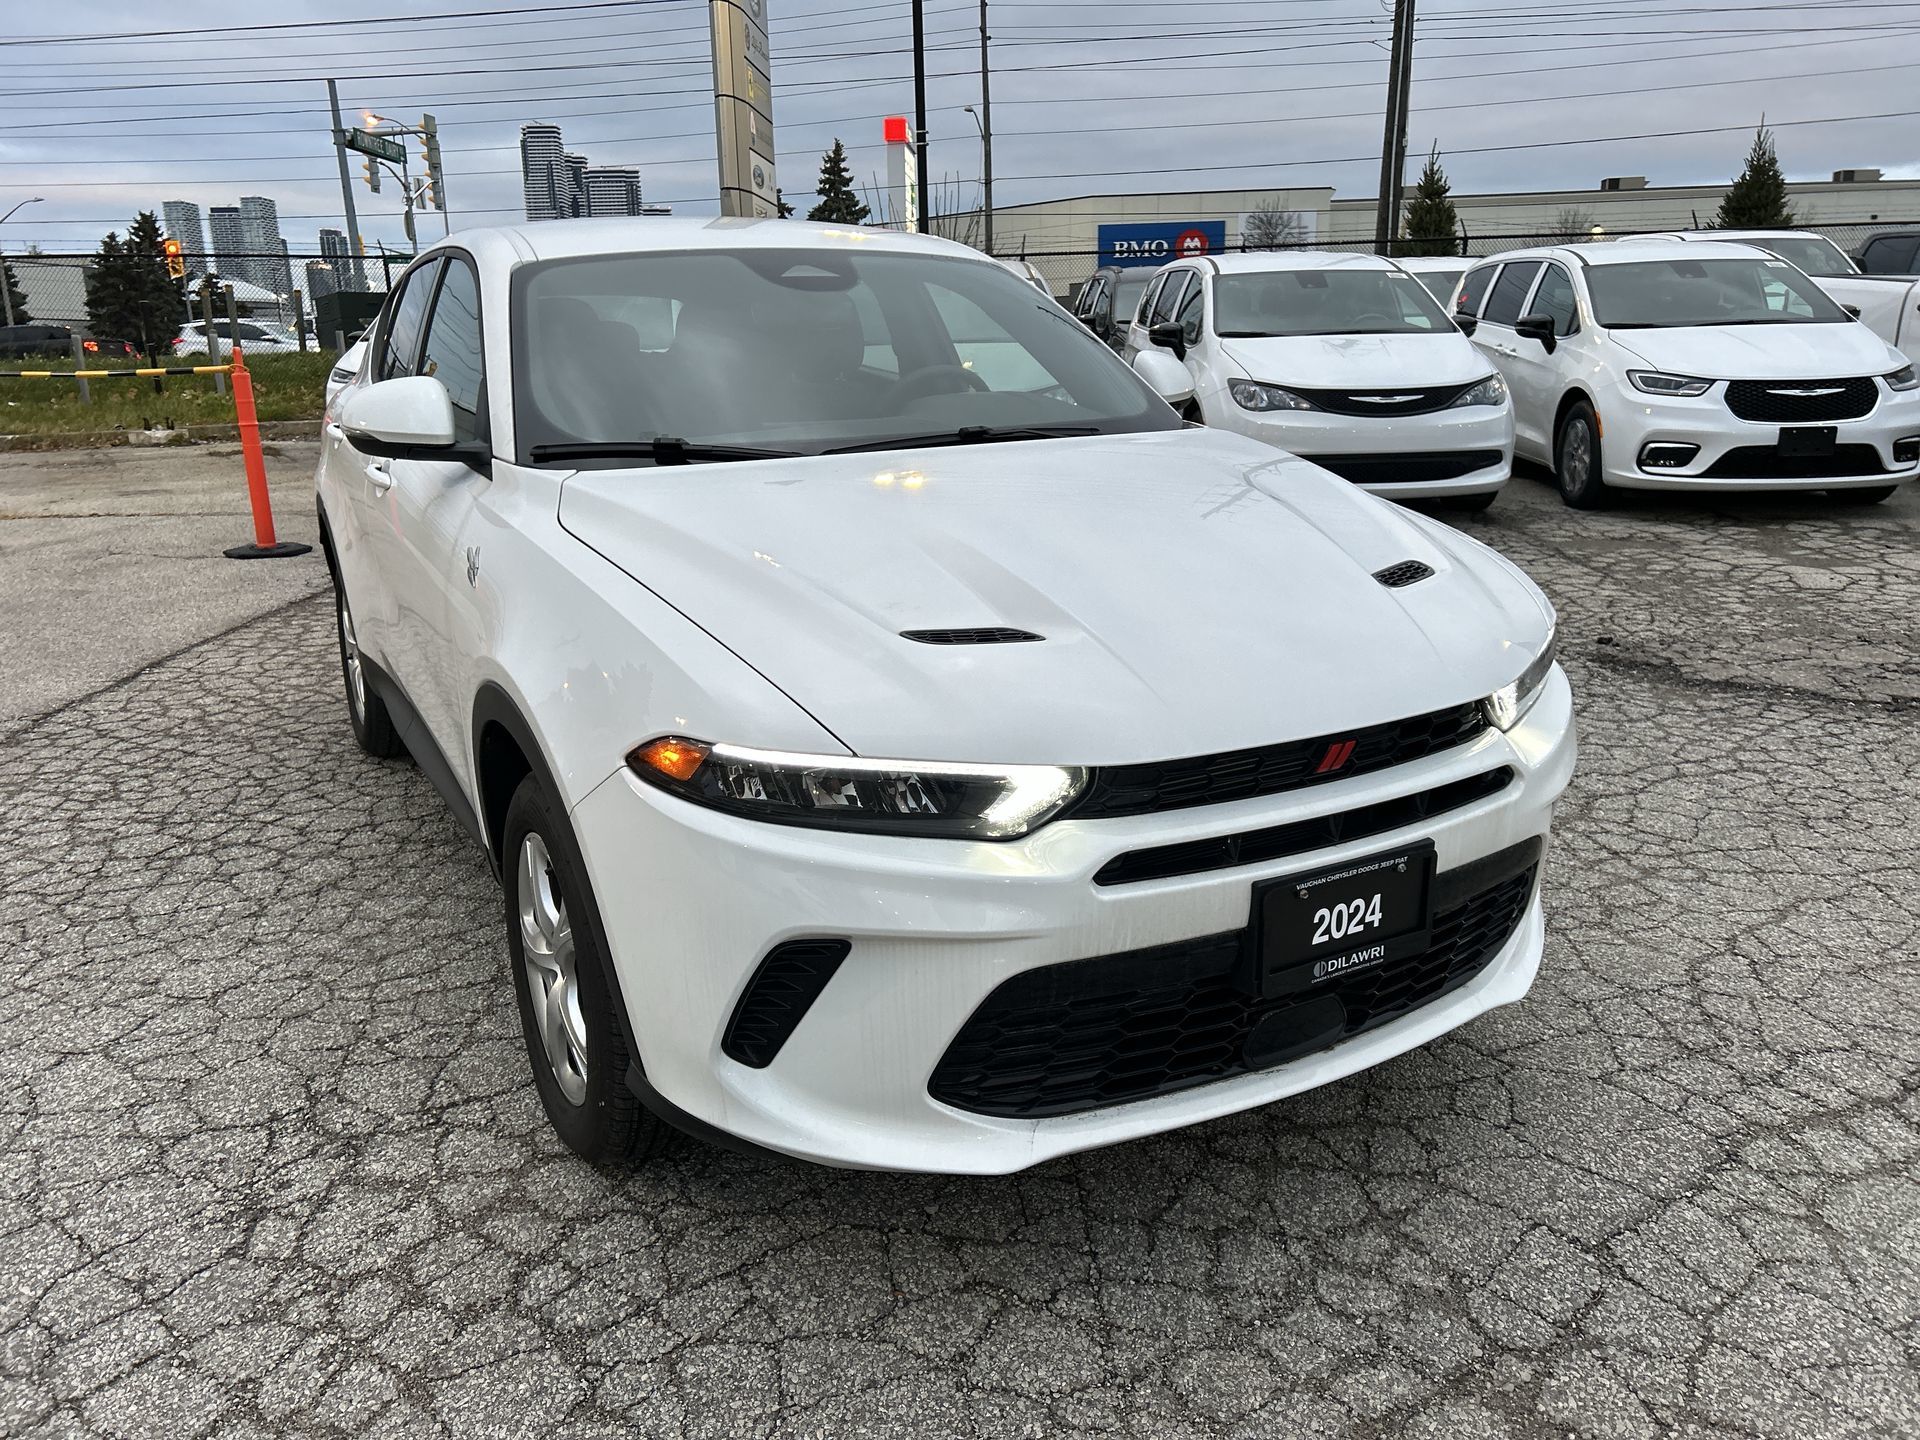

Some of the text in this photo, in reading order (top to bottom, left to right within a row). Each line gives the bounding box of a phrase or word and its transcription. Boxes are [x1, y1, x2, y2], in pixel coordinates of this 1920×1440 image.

[1113, 239, 1169, 258] BMO
[1296, 856, 1408, 890] VAUGHAN CHRYSLER DODGE JEEP FIAT
[1311, 893, 1383, 945] 2024
[1328, 945, 1384, 972] DILAWRI
